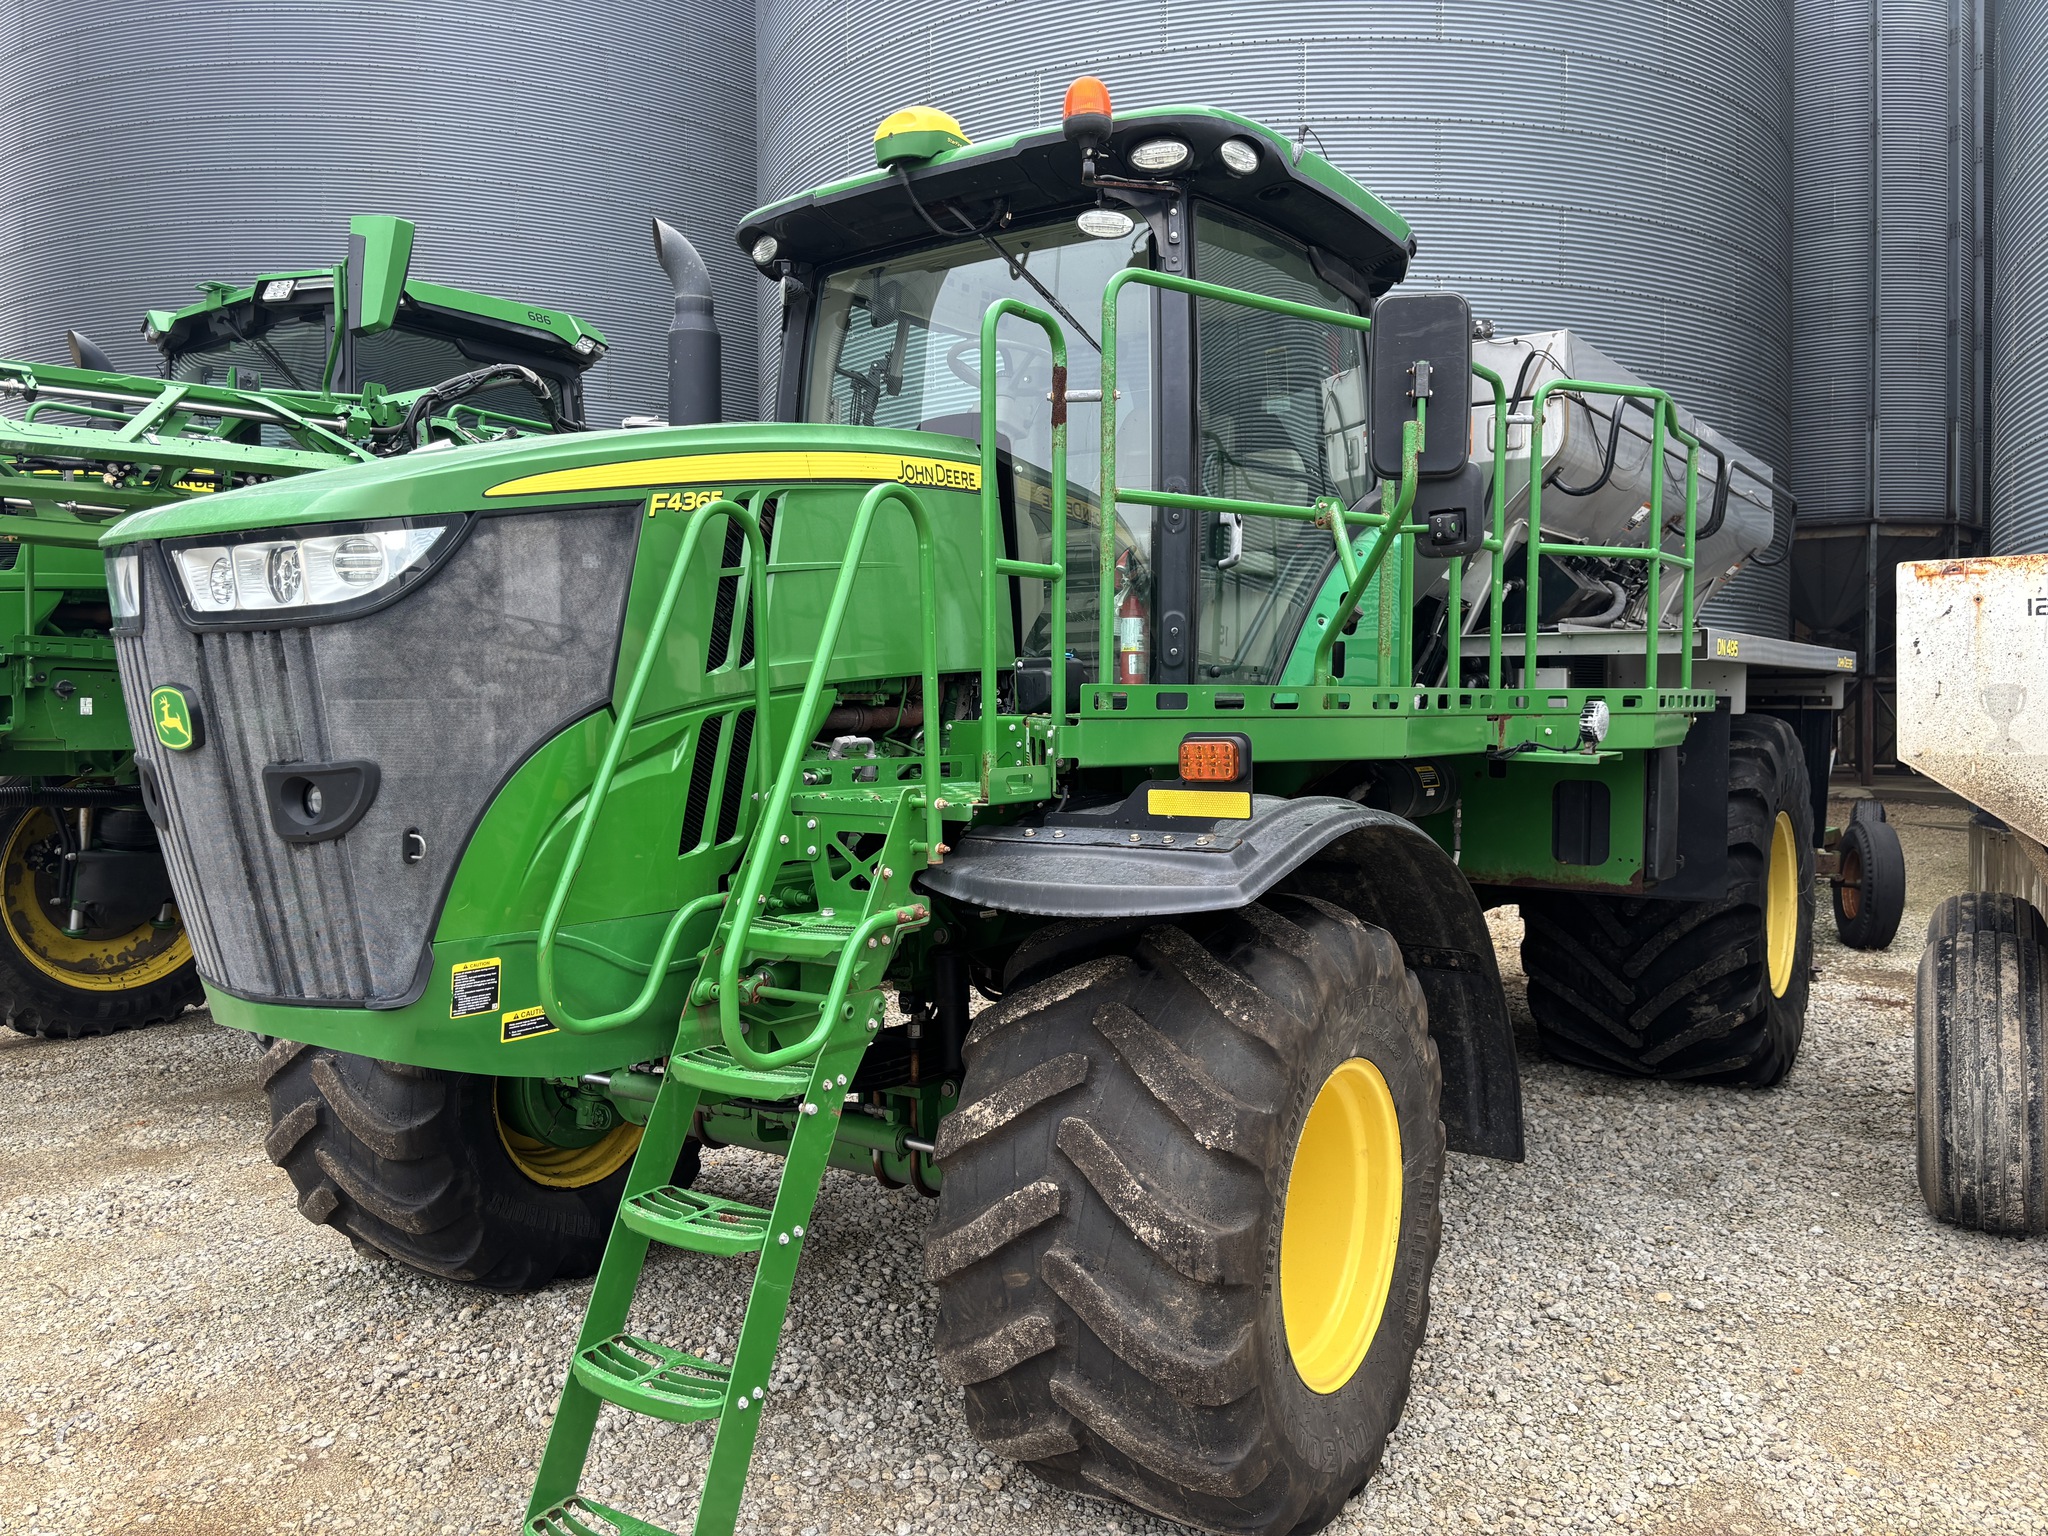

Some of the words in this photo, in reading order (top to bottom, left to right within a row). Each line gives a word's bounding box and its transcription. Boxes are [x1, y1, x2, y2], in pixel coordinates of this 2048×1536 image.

[528, 311, 552, 325] 686
[897, 460, 934, 482] JOHN
[935, 463, 976, 487] DEERE
[1716, 637, 1726, 656] DN
[470, 961, 491, 969] CAUTION
